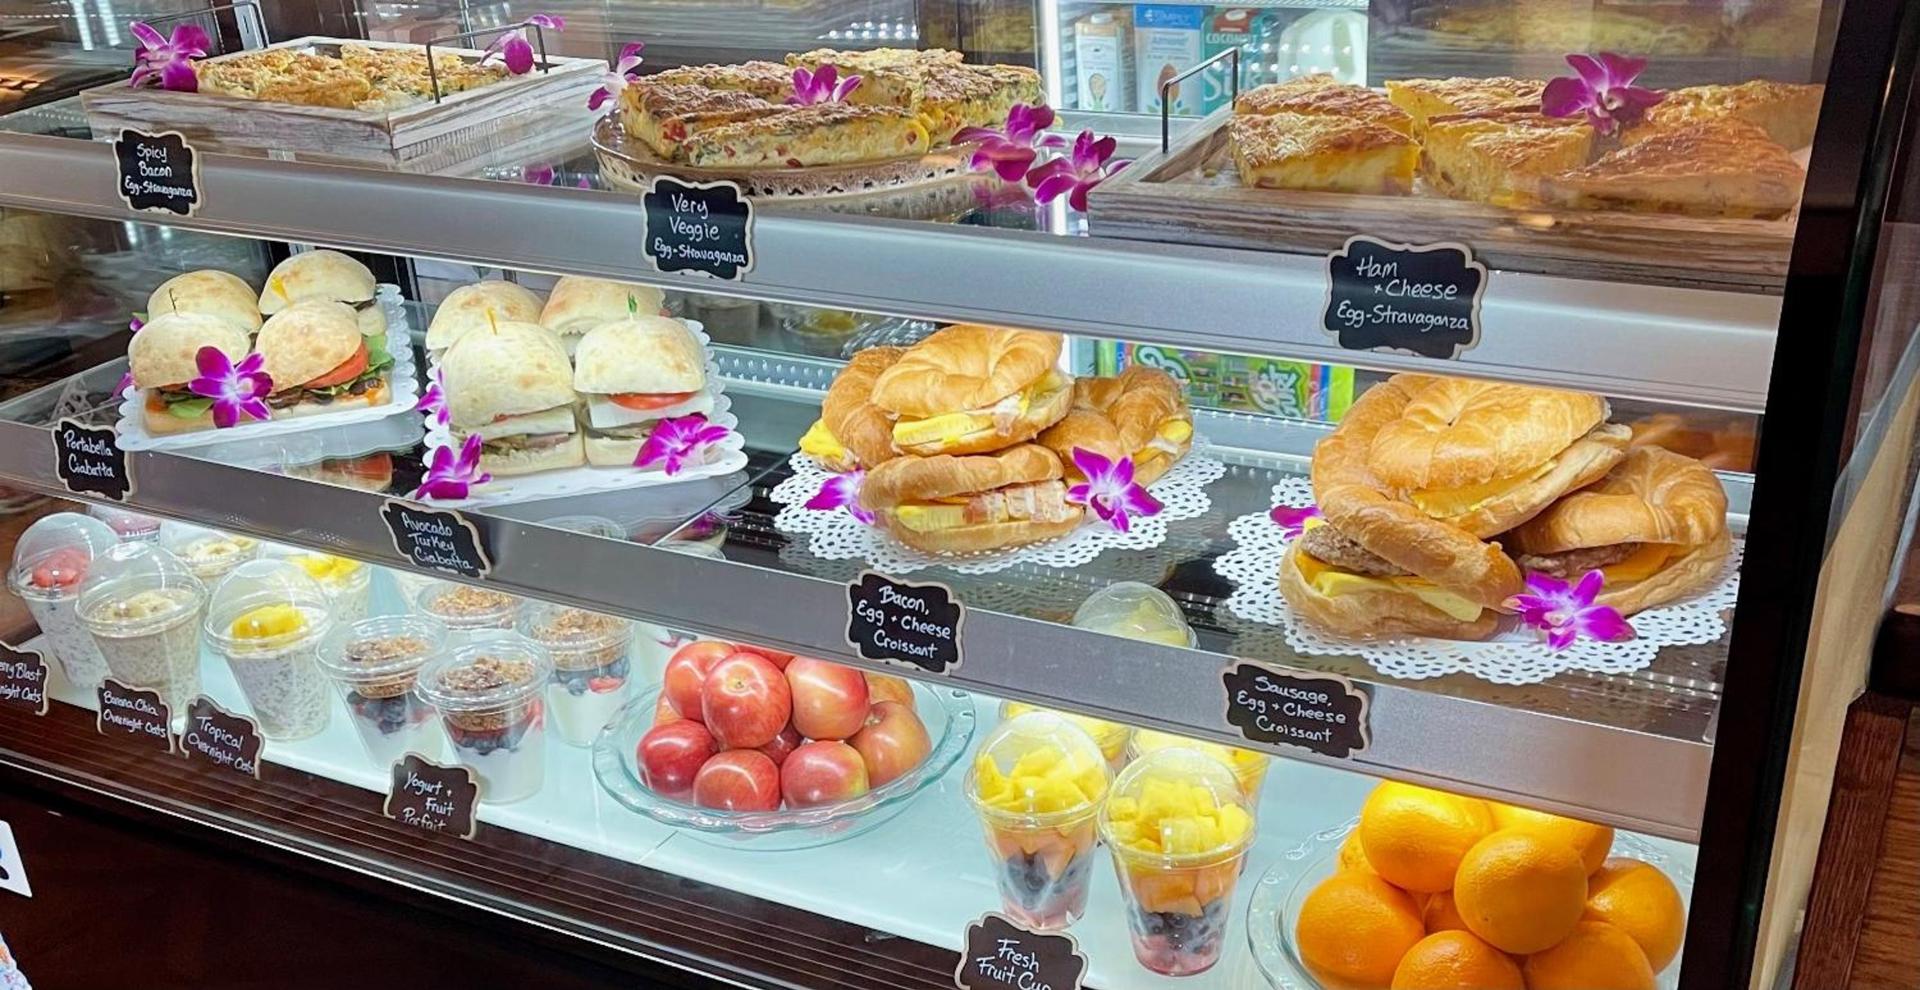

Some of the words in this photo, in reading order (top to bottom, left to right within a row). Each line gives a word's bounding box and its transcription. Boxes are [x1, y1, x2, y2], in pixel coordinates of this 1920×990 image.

[136, 143, 167, 163] Spicy
[138, 160, 173, 177] Bacon
[671, 192, 709, 220] Very
[669, 216, 720, 241] Veggie
[654, 237, 746, 266] Egg-Stravaganza
[1356, 255, 1398, 277] Ham
[1385, 279, 1458, 300] Cheese
[1337, 300, 1470, 332] Egg-Stravaganza
[63, 429, 114, 456] Portabella
[68, 453, 115, 478] Ciabatta
[401, 512, 453, 537] Avocado
[408, 532, 457, 556] Turkey
[414, 546, 474, 570] Ciabatta
[879, 585, 930, 615] Bacon,
[856, 600, 885, 626] Egg
[901, 616, 951, 639] Cheese
[873, 629, 938, 659] Croissant
[15, 663, 43, 681] Blast
[21, 687, 42, 703] Oats
[103, 690, 135, 710] Banana
[135, 698, 159, 717] Chia
[1255, 676, 1332, 707] Sausage,
[1237, 690, 1267, 713] Egg
[1283, 703, 1347, 724] Cheese
[103, 709, 144, 733] Overnight
[145, 722, 167, 738] Oats
[196, 716, 244, 750] Tropical
[1256, 715, 1333, 743] Croissant
[187, 733, 235, 764] Overnight
[234, 757, 254, 775] Oats
[403, 771, 443, 795] Yogurt
[425, 797, 455, 816] Fruit
[997, 939, 1039, 973] Fresh
[976, 956, 1016, 984] Fruit
